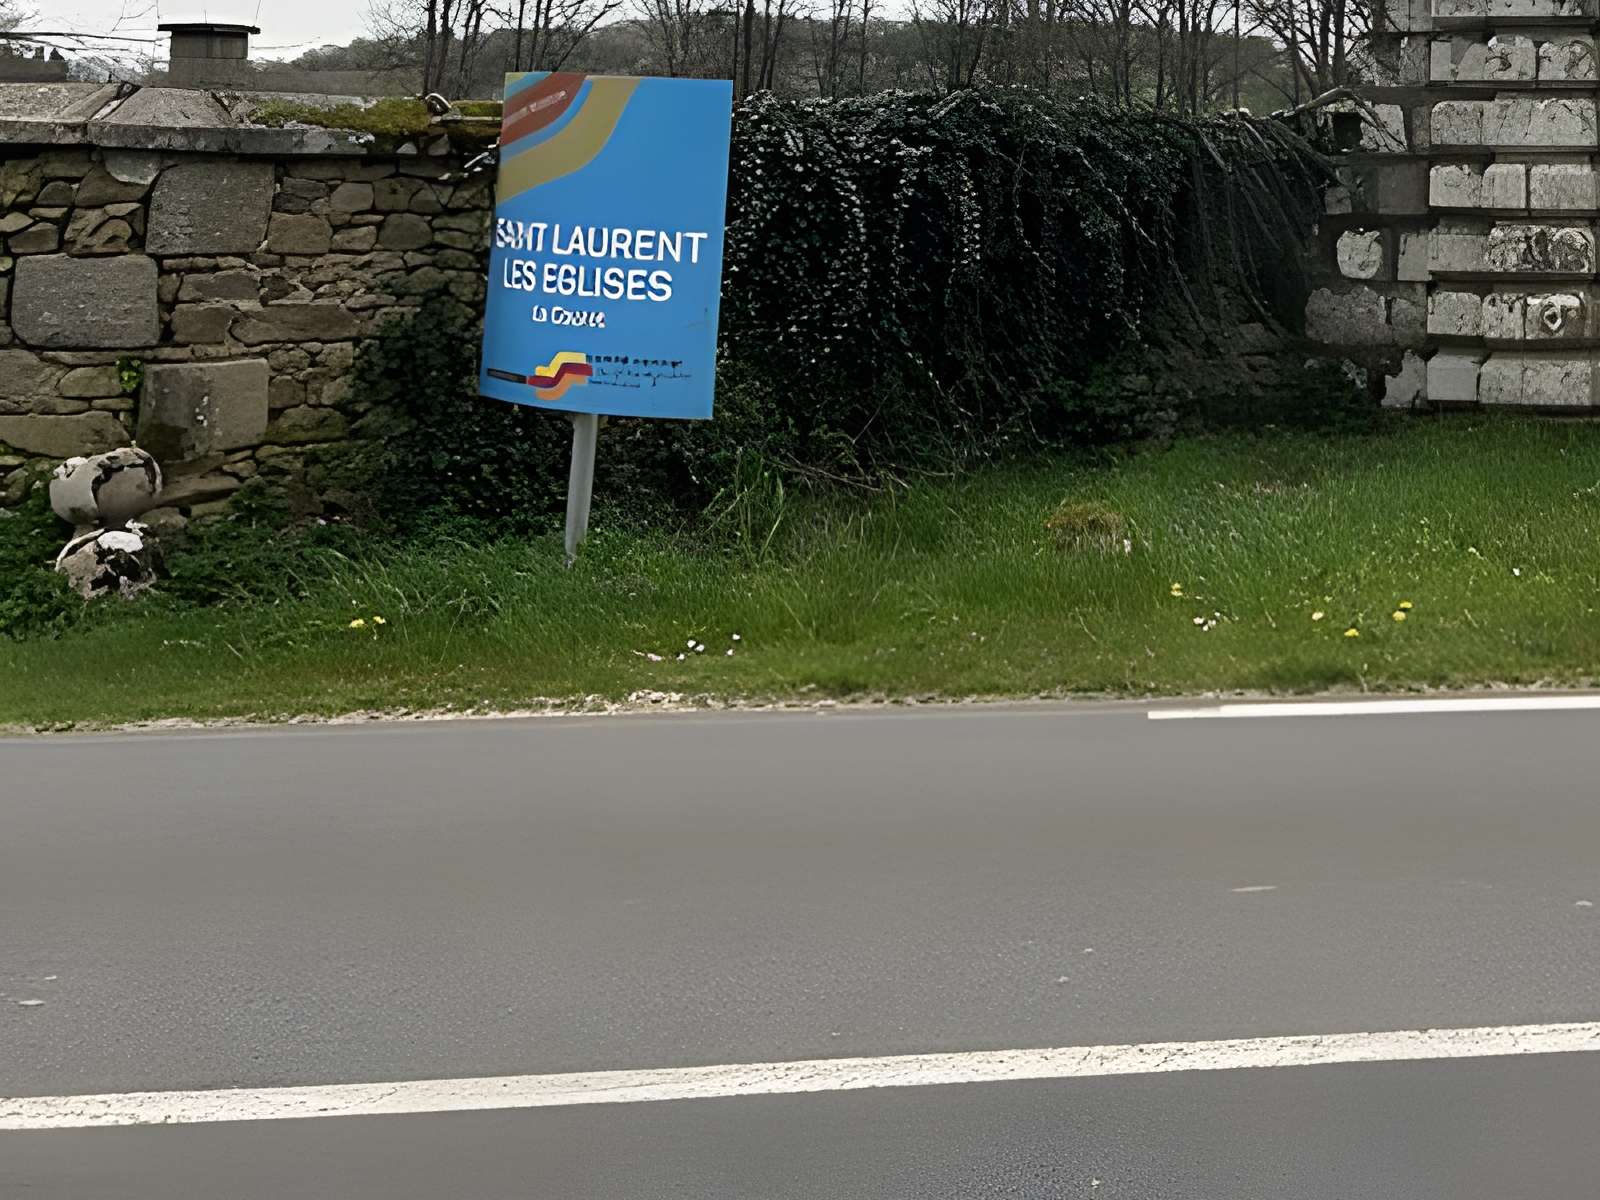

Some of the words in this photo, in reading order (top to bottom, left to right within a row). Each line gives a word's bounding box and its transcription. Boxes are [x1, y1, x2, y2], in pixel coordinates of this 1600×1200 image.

[552, 223, 708, 264] LAURENT
[503, 258, 537, 292] LES
[543, 263, 673, 302] EGLISES
